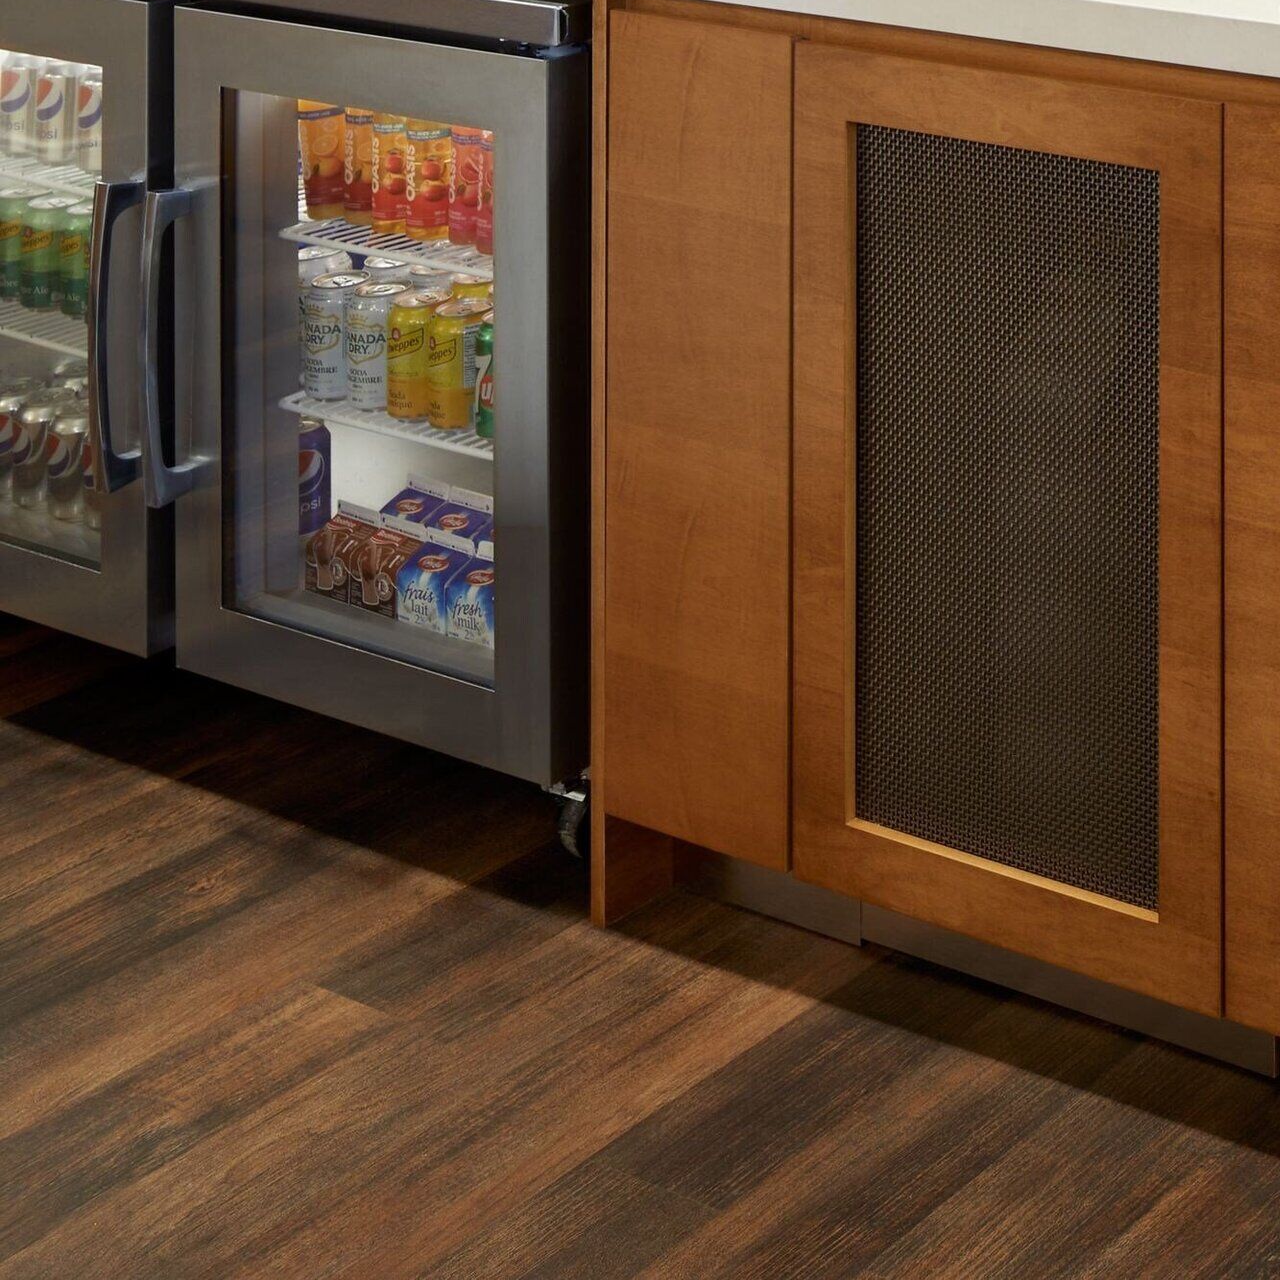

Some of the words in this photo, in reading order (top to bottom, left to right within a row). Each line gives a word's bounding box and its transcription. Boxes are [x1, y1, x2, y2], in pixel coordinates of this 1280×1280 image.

[344, 128, 354, 185] OASIS
[371, 137, 380, 194] OASIS
[405, 144, 416, 201] OASIS
[304, 320, 342, 335] NADA
[346, 331, 387, 344] ANADA
[348, 342, 370, 355] DRY
[404, 580, 434, 604] frais
[411, 598, 429, 617] lait
[452, 595, 484, 620] fresh
[457, 617, 482, 634] milk
